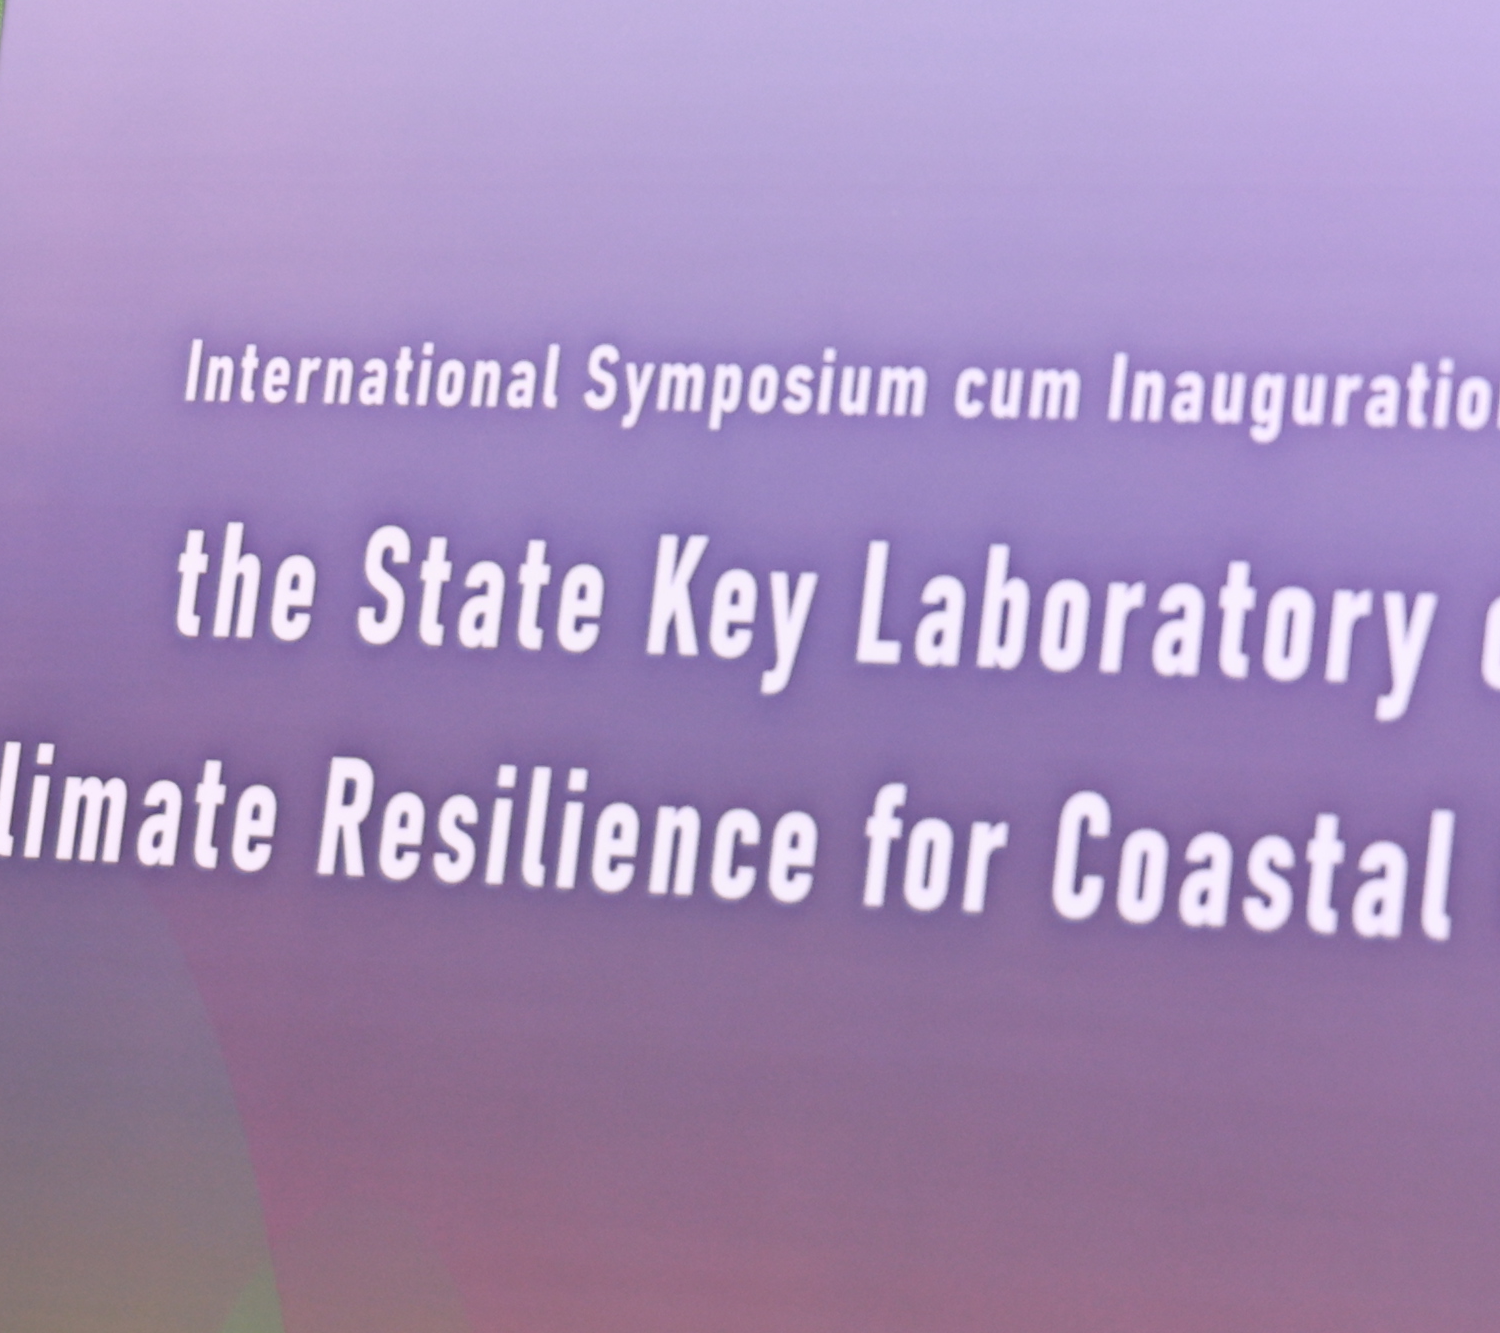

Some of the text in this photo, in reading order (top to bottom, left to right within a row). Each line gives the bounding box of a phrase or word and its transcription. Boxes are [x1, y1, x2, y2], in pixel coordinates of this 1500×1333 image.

[184, 339, 561, 410] International
[583, 344, 928, 430] Symposium
[955, 364, 1082, 421] cum
[175, 522, 316, 642] the
[358, 525, 605, 653] State
[645, 535, 819, 695] Key
[857, 539, 1438, 722] Laboratory
[317, 756, 819, 903] Resilience
[862, 783, 1008, 914] for
[1053, 790, 1456, 942] Coastal
